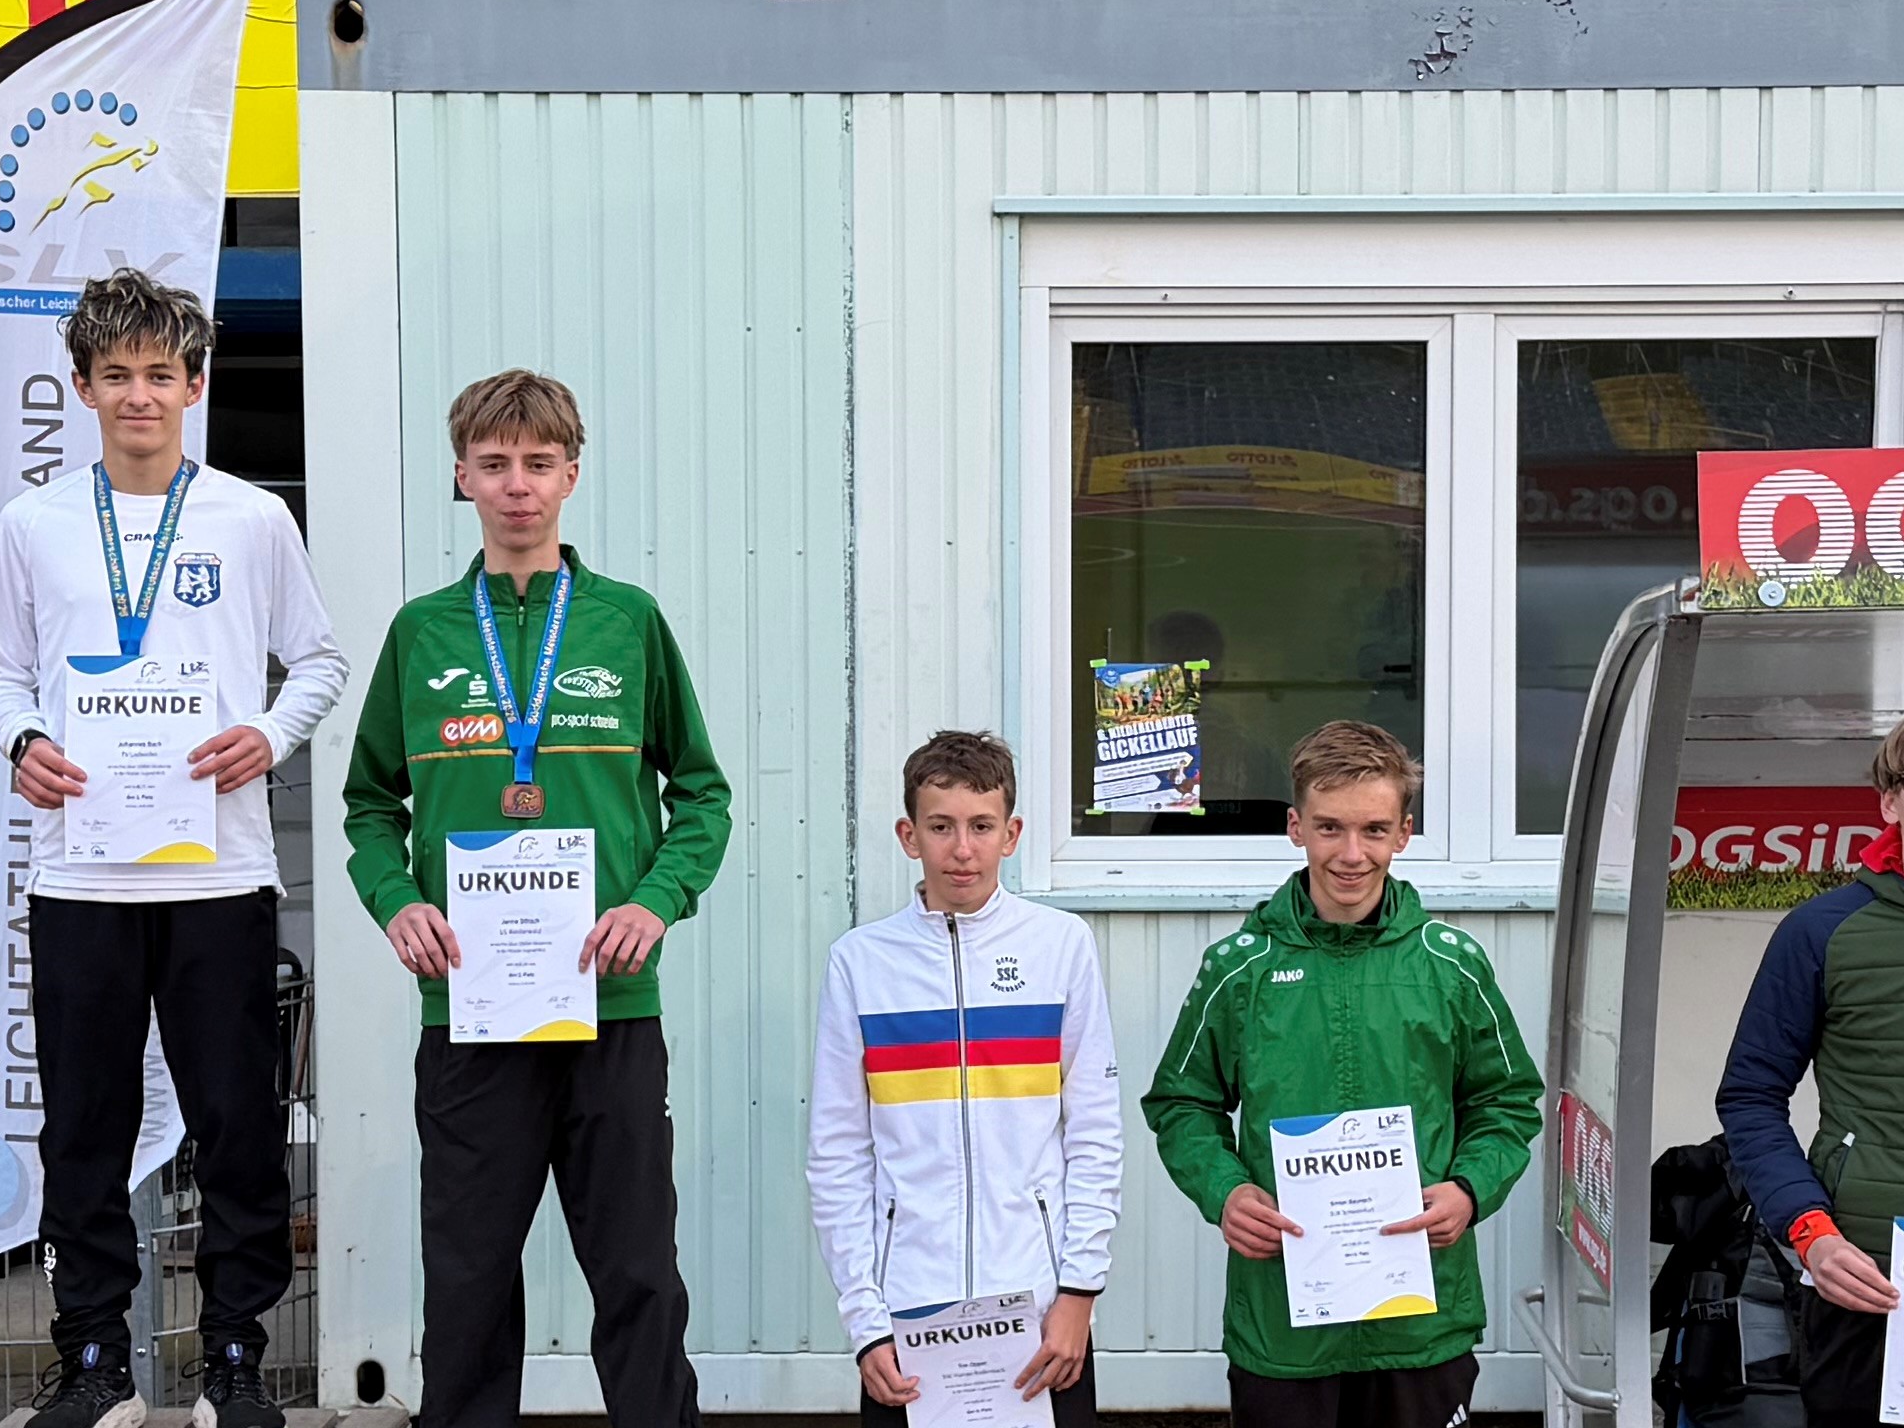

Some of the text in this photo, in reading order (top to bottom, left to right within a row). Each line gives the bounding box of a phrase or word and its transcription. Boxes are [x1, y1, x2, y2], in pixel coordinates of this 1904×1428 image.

[39, 296, 79, 312] Leicht
[77, 695, 202, 718] URKUNDE
[1096, 726, 1199, 762] GICKELLAUF
[458, 870, 581, 894] URKUNDE
[996, 966, 1019, 982] SSC
[1270, 967, 1305, 983] JAKO
[1285, 1147, 1403, 1177] URKUNDE
[905, 1318, 1026, 1349] URKUNDE
